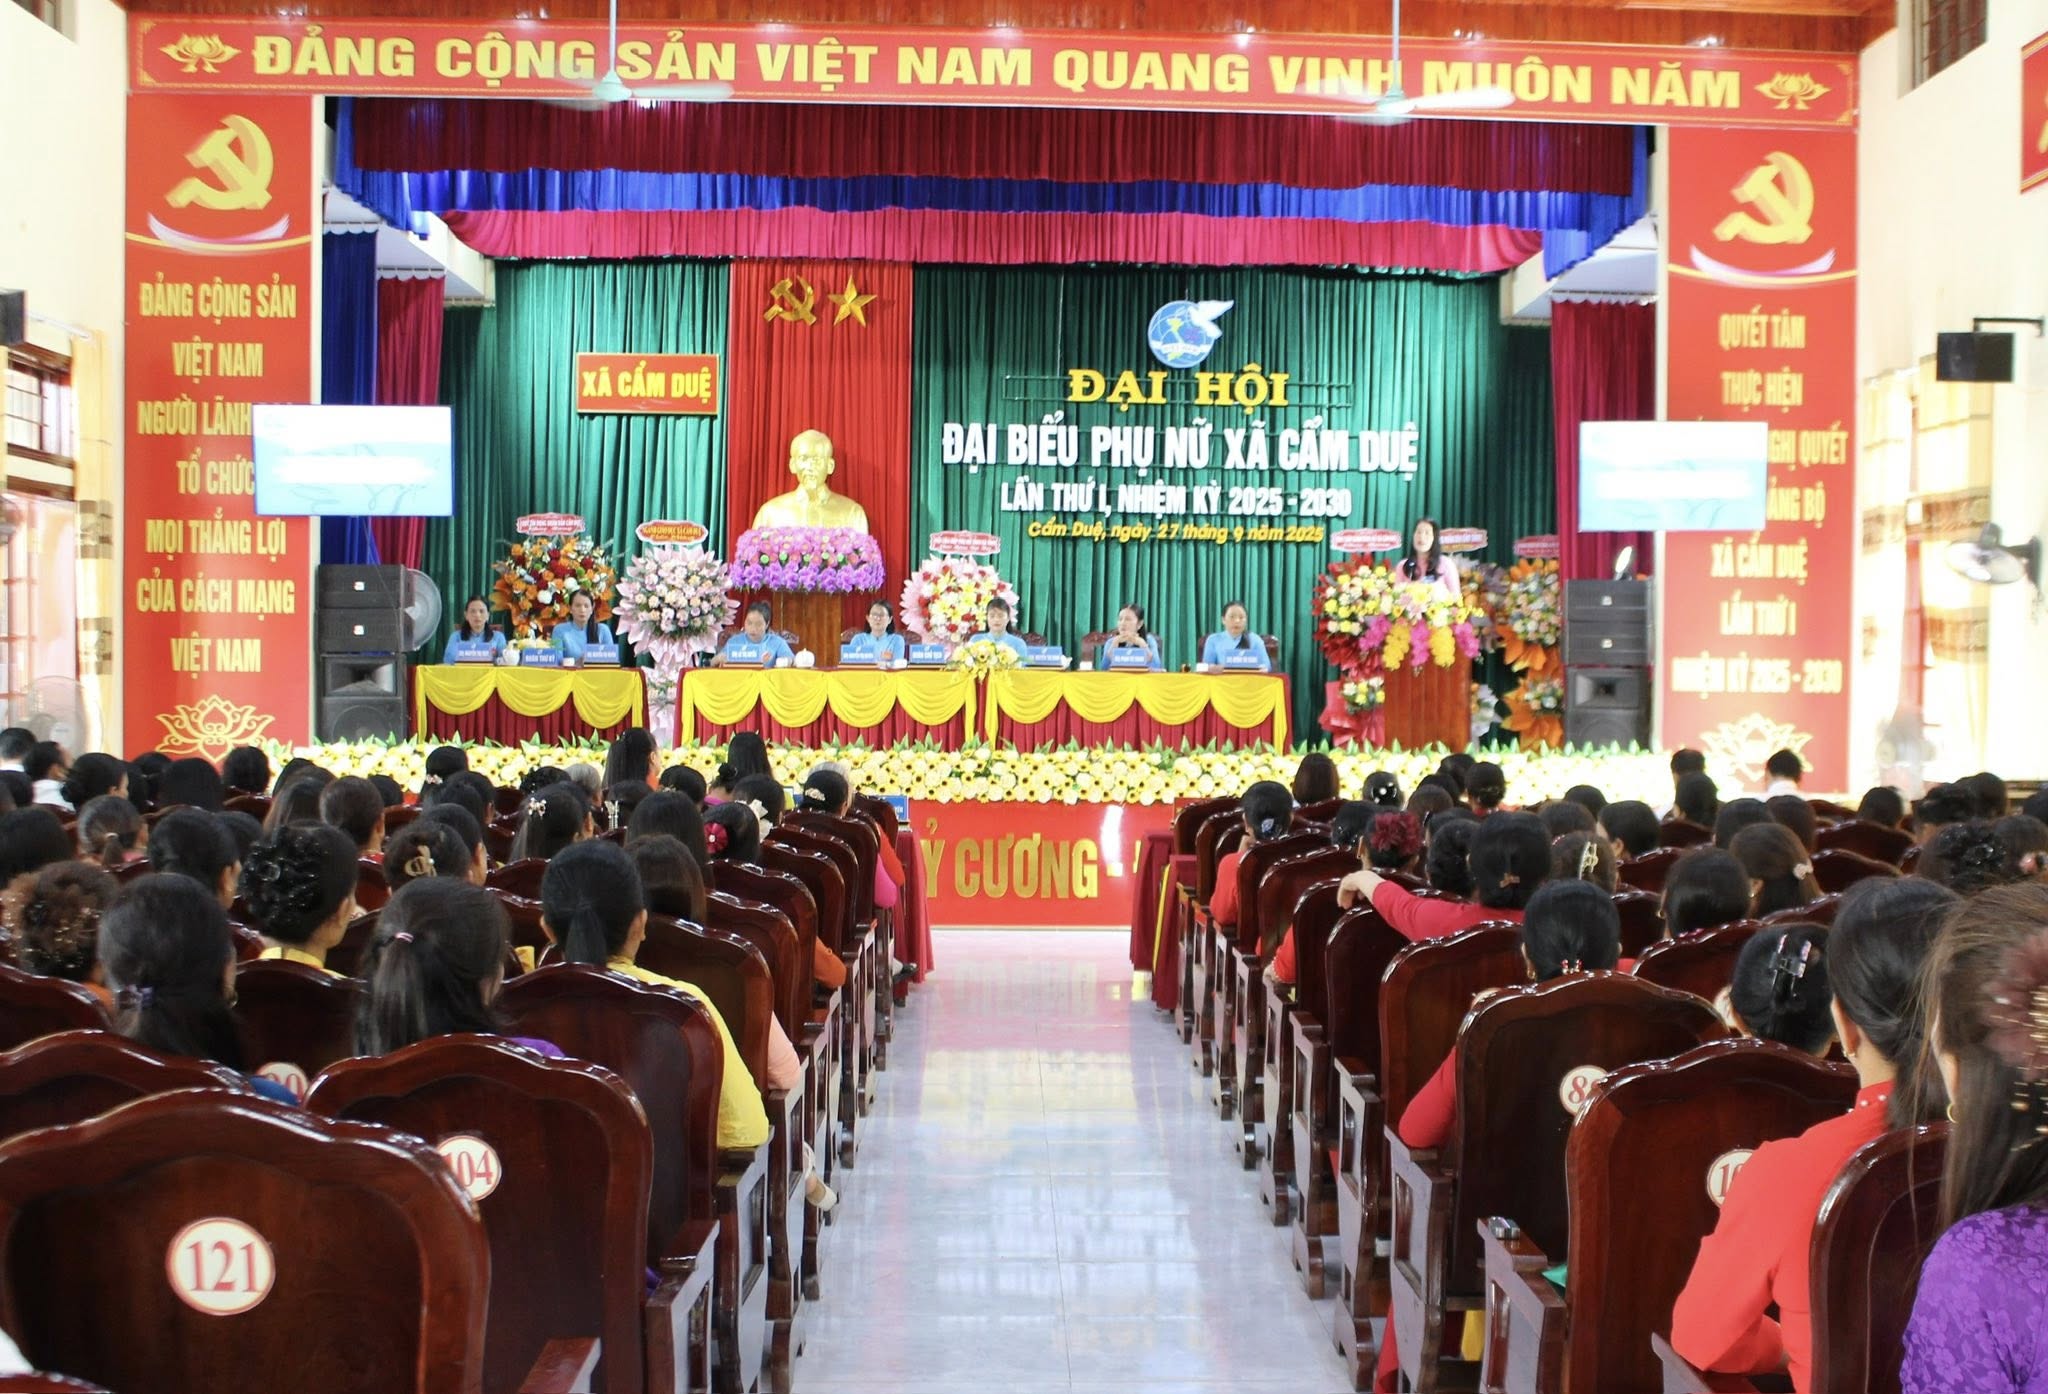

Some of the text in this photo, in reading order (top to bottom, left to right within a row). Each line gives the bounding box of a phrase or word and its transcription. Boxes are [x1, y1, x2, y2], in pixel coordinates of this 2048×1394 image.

[252, 24, 1740, 108] ĐẢNG CỘNG SẢN VIỆT NAM QUANG VINH MUÔN NĂM
[139, 272, 297, 325] ĐẢNG CỘNG SẢN
[172, 335, 263, 384] VIỆT NAM
[582, 366, 612, 397] XÃ
[671, 367, 711, 404] DUỆ
[1067, 363, 1289, 415] ĐẠI HỘI
[137, 393, 252, 436] NGƯỜI LÃNH
[942, 422, 997, 473] ĐẠI
[1007, 410, 1078, 467] BIỂU
[1091, 426, 1154, 477] PHỤ
[1164, 417, 1213, 469] NỮ
[1224, 419, 1269, 470] XÃ
[1359, 421, 1419, 481] DUỆ
[176, 447, 255, 495] TỔ CHỨC
[1001, 475, 1352, 519] LẦN THỨ I, NHIỆM KỲ 2025 - 2030
[146, 519, 183, 561] MỌI
[257, 517, 286, 562] LỢI
[1111, 522, 1152, 543] ngày
[1157, 523, 1179, 539] 27
[1182, 523, 1229, 544] tháng
[1233, 525, 1244, 542] 9
[1247, 525, 1284, 540] năm
[1285, 526, 1324, 542] 2025
[137, 567, 294, 621] CỦA CÁCH MẠNG
[170, 631, 261, 679] VIỆT NAM
[954, 833, 1098, 899] CƯƠNG
[188, 1240, 263, 1293] 121
